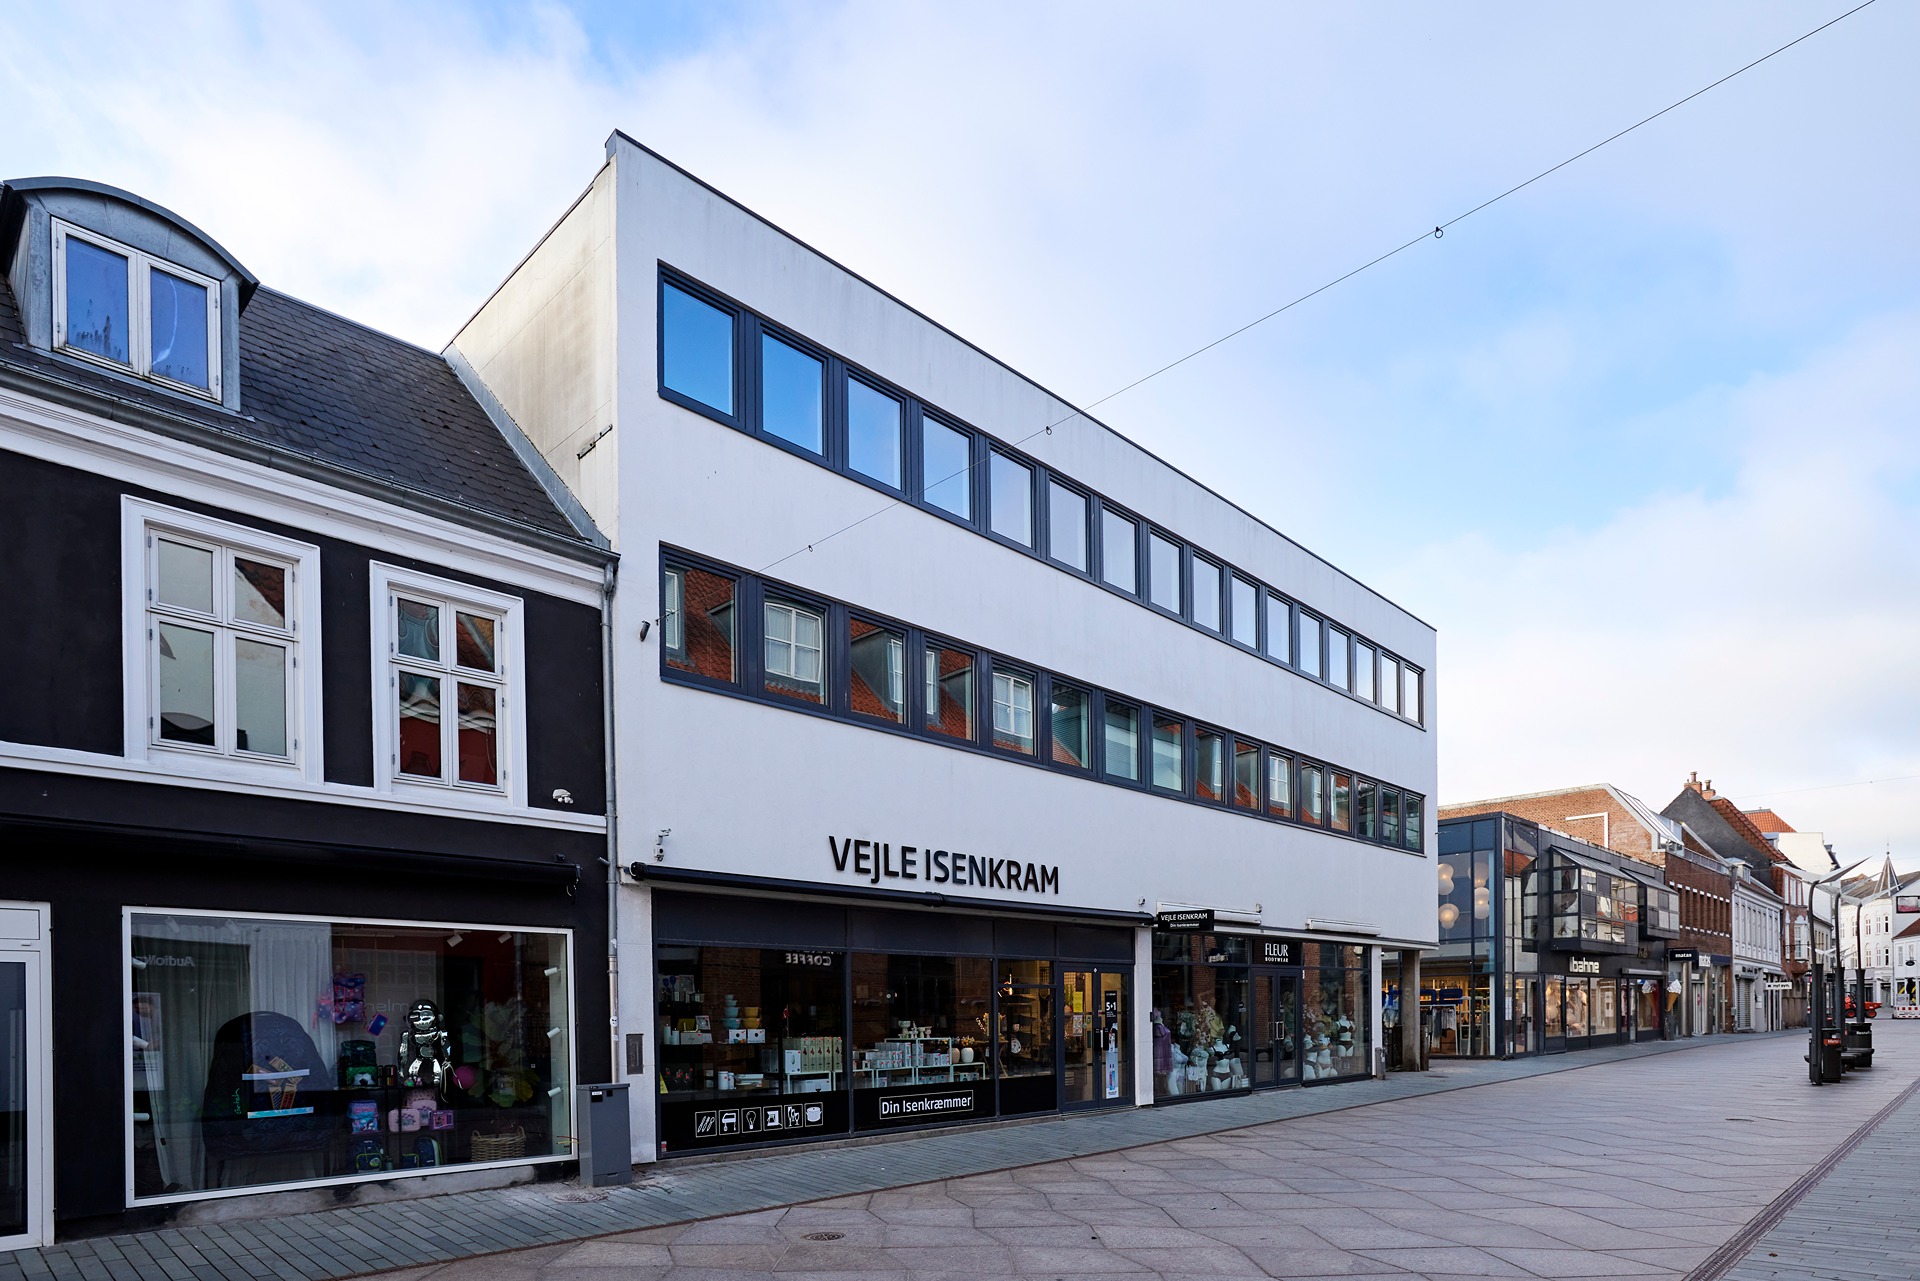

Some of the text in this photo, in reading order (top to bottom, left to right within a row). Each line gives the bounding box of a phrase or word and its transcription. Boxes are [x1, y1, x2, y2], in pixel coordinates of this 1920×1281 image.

[828, 836, 1059, 894] VEJLE ISENKRAM
[1160, 914, 1177, 922] VEJLE
[1265, 943, 1289, 957] FLEUR
[1569, 957, 1600, 973] bahne
[881, 1097, 971, 1114] Din Isenkræmmer
